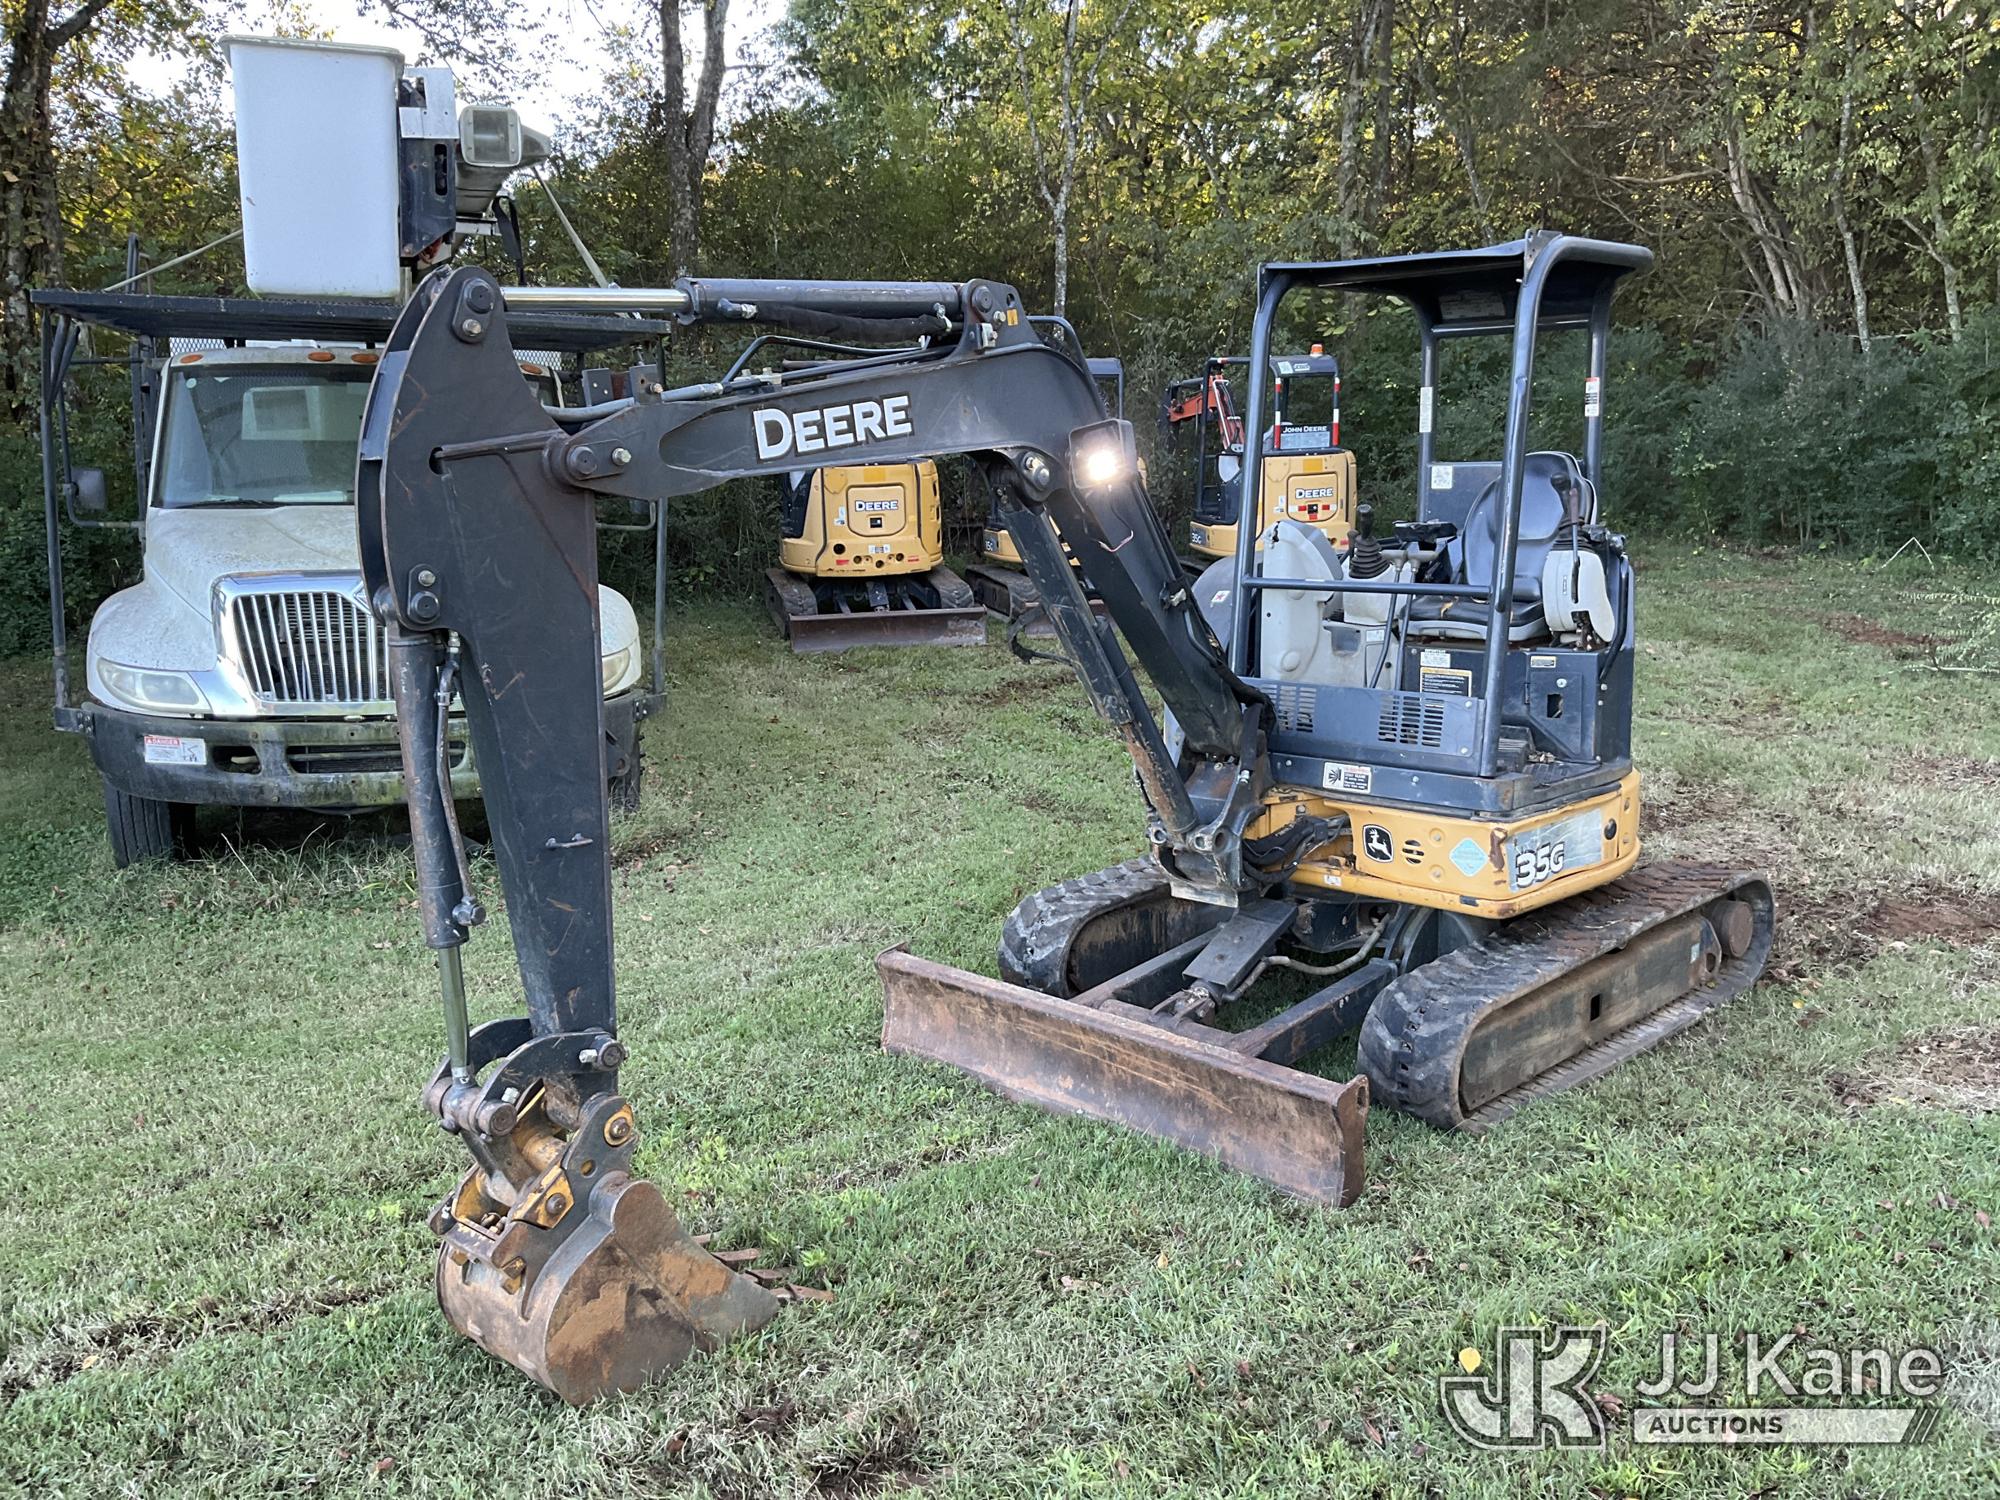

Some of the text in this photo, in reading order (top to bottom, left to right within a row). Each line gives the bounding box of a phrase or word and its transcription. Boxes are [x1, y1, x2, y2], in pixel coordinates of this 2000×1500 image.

[753, 395, 913, 460] DEERE
[855, 501, 899, 512] DEERE
[1295, 488, 1333, 499] DEERE
[1515, 841, 1565, 887] 35G
